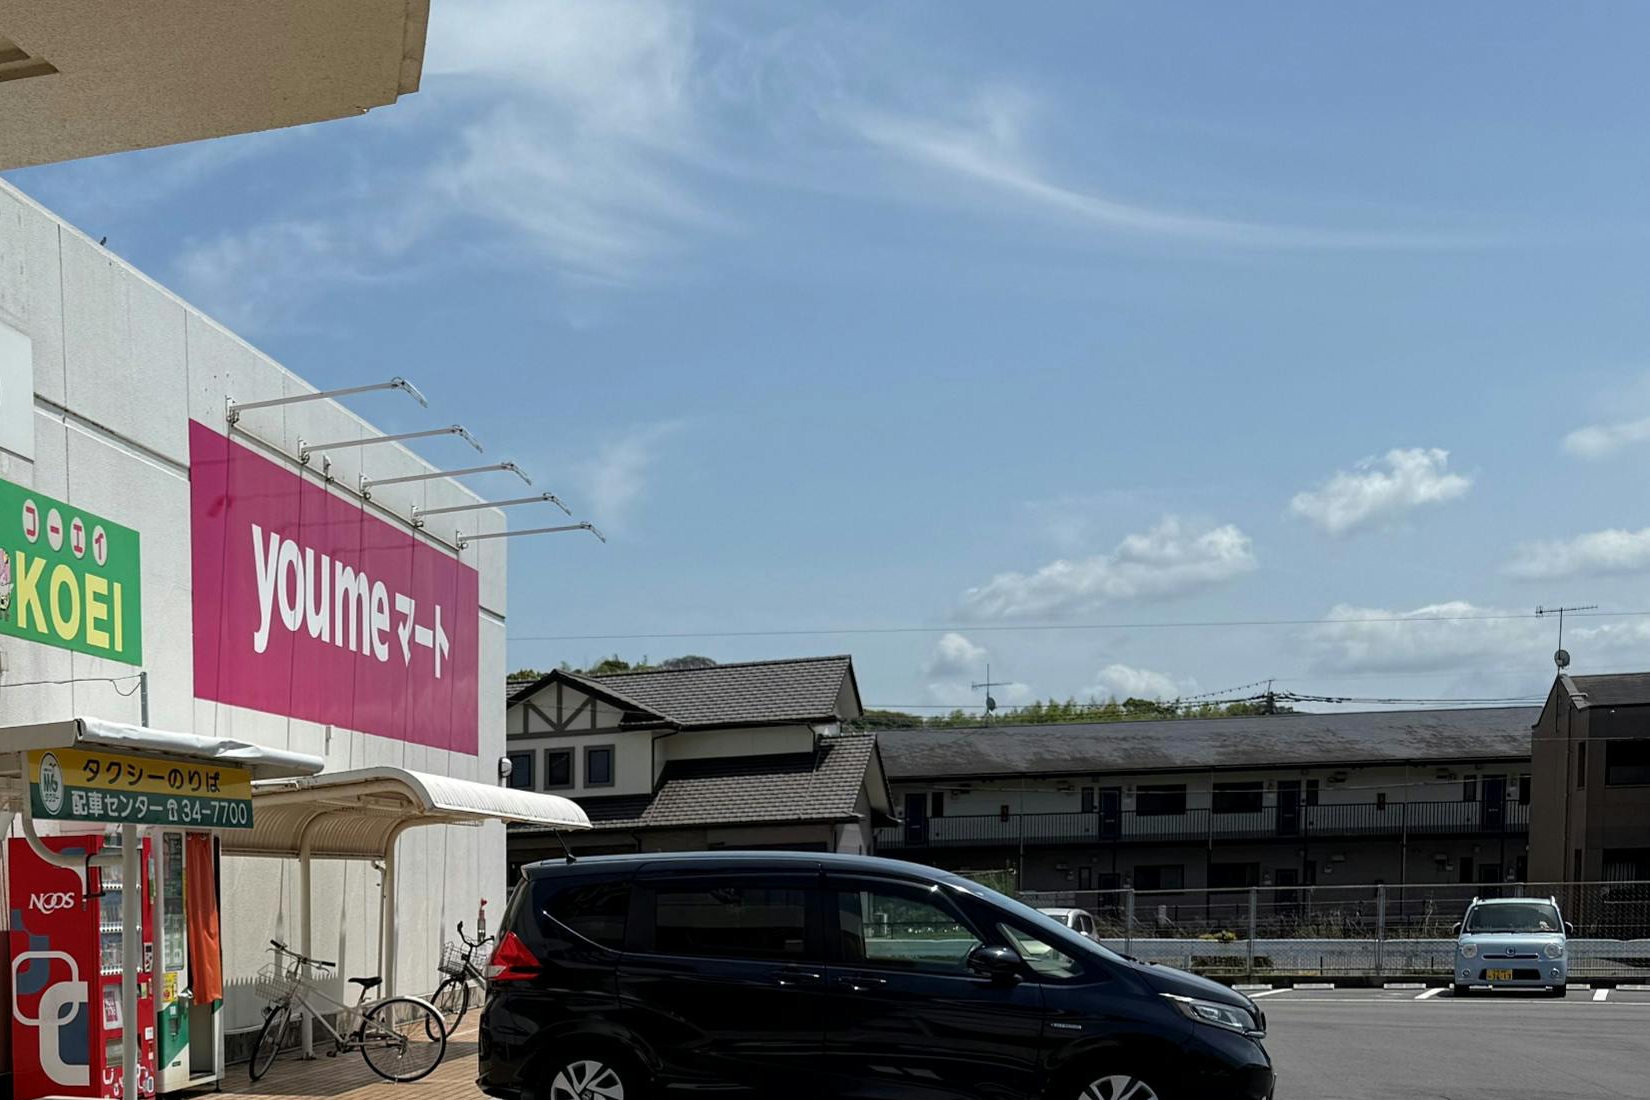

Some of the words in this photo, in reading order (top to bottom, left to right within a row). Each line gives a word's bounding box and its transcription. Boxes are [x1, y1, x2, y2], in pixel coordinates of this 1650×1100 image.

[24, 501, 108, 564] コーエイ
[16, 549, 124, 652] KOEI
[83, 759, 221, 793] タクシーのりば
[72, 790, 164, 819] 配車センター
[181, 799, 248, 825] 34-7700
